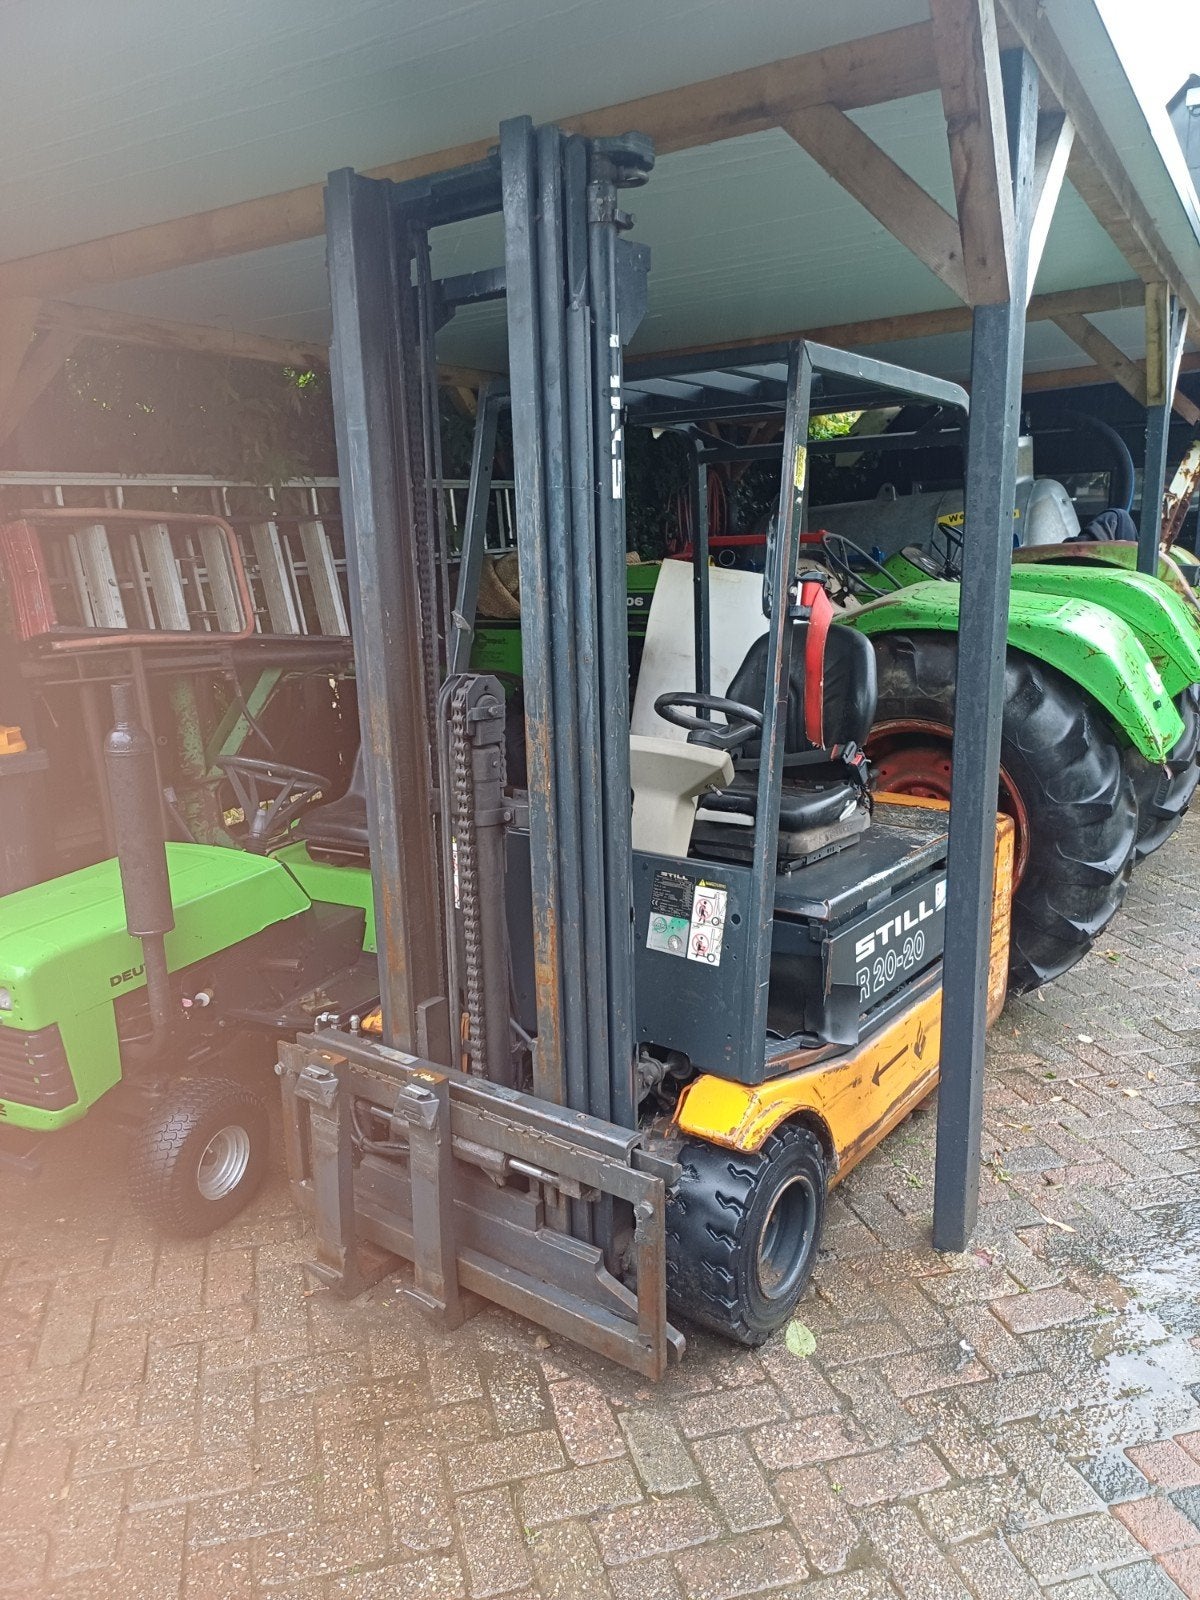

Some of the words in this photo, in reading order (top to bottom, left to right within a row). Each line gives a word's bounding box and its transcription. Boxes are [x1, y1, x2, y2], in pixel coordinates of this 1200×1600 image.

[855, 901, 933, 963] STILL
[110, 963, 146, 987] DEU
[856, 967, 870, 1003] R
[873, 930, 924, 992] 20-20
